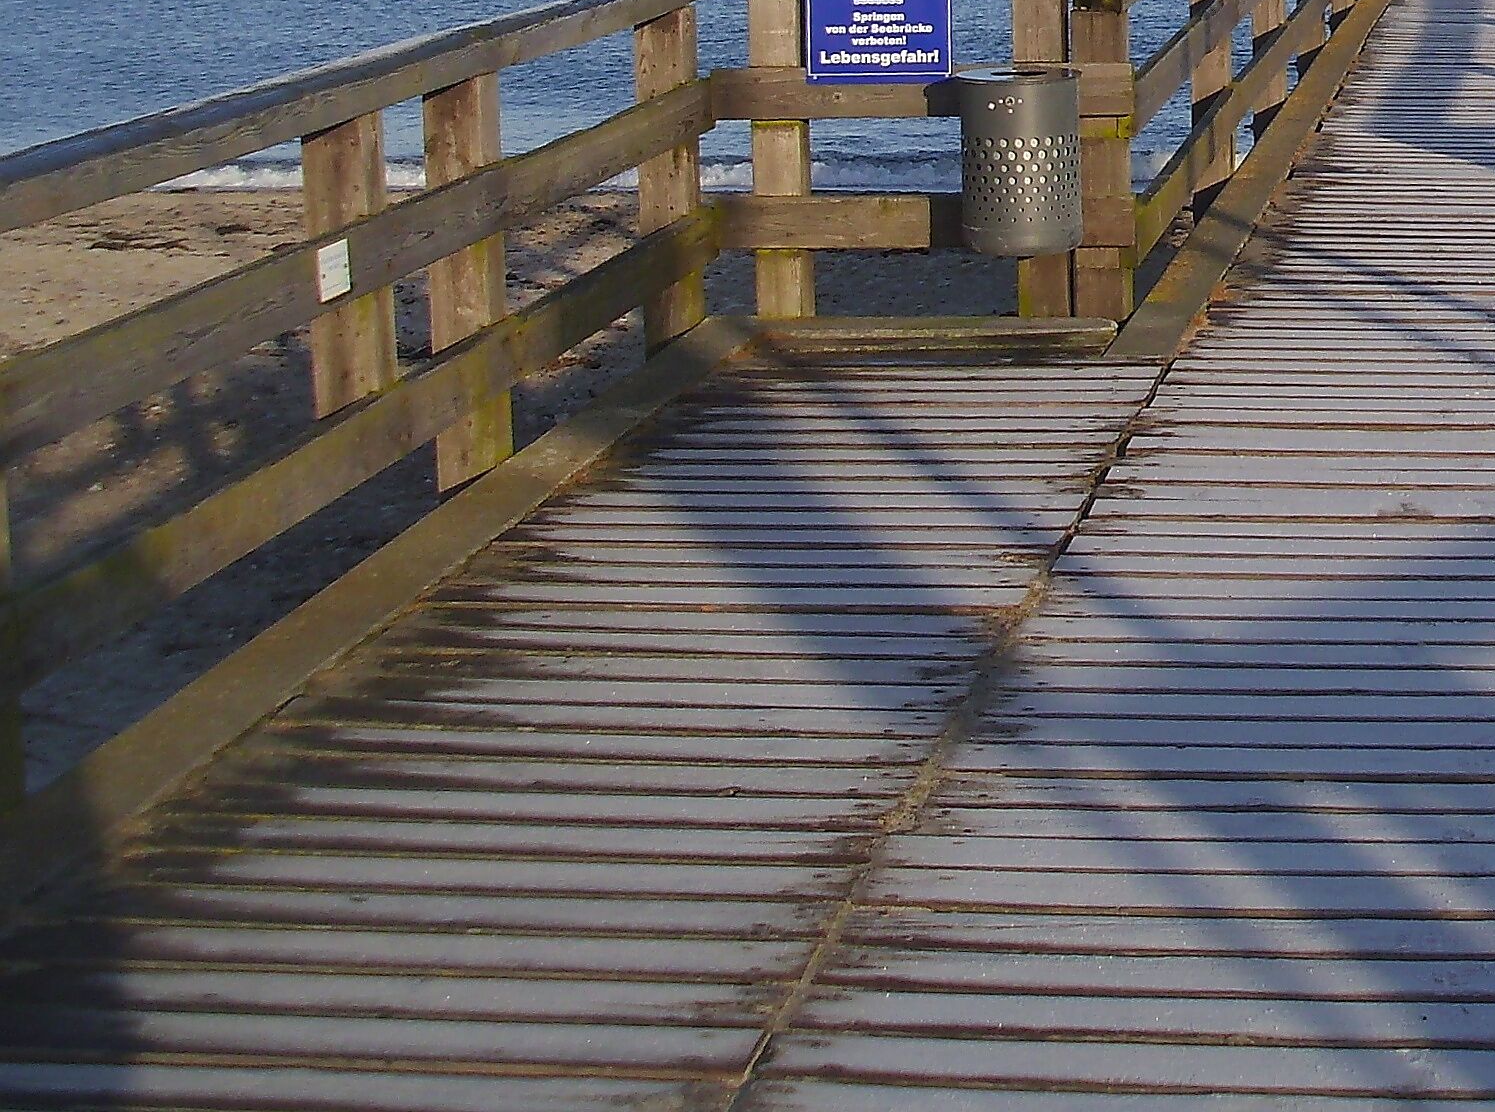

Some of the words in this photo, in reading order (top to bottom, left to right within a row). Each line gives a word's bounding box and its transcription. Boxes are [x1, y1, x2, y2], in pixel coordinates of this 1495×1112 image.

[852, 12, 905, 24] Springen
[825, 26, 846, 34] von
[848, 24, 869, 34] der
[870, 23, 933, 33] Seebrücke
[851, 35, 907, 46] verboten!
[820, 49, 940, 67] Lebensgefahr!
